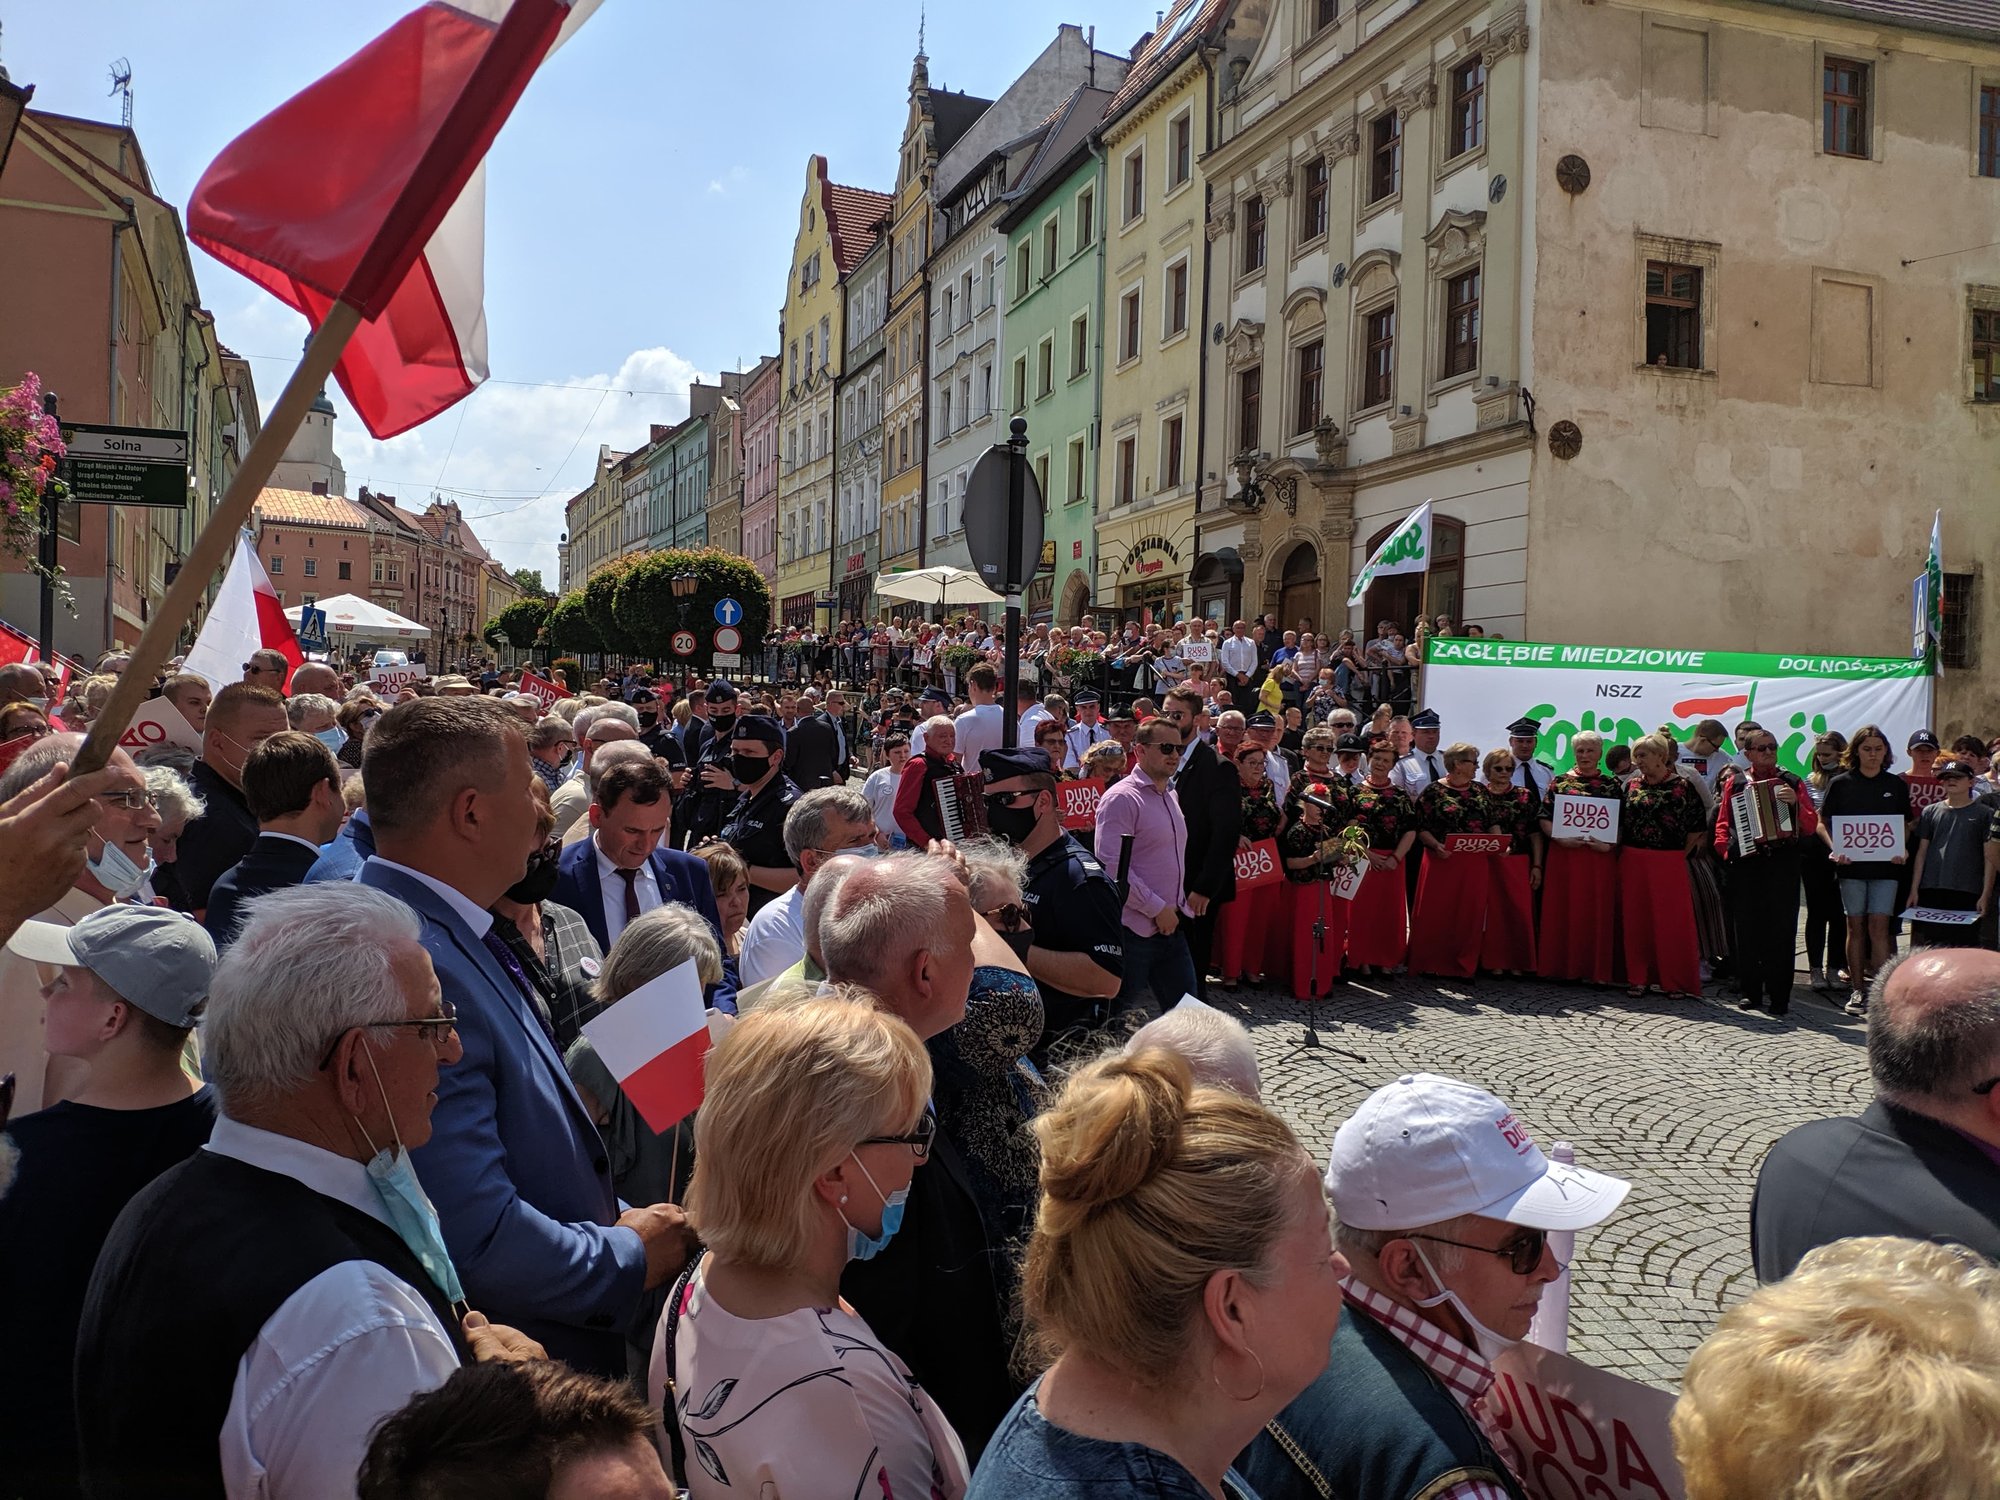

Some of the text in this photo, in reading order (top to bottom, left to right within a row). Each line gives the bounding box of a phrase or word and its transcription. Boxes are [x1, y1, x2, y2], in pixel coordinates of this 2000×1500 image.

[103, 438, 142, 452] Solna
[676, 637, 693, 649] 20
[1433, 640, 1555, 665] ZAGŁĘBIE
[1561, 645, 1706, 667] MIEDZIOWE
[529, 681, 558, 703] DUD
[1595, 683, 1643, 699] NSZZ
[1065, 786, 1101, 802] DUDA
[1910, 783, 1948, 798] DUD
[1563, 802, 1610, 818] DUDA
[1562, 814, 1610, 830] 2020
[1842, 822, 1894, 836] DUDA
[1452, 845, 1500, 853] 2020
[1455, 838, 1501, 847] DUDA
[1843, 835, 1896, 849] 2020
[1235, 859, 1274, 881] 020
